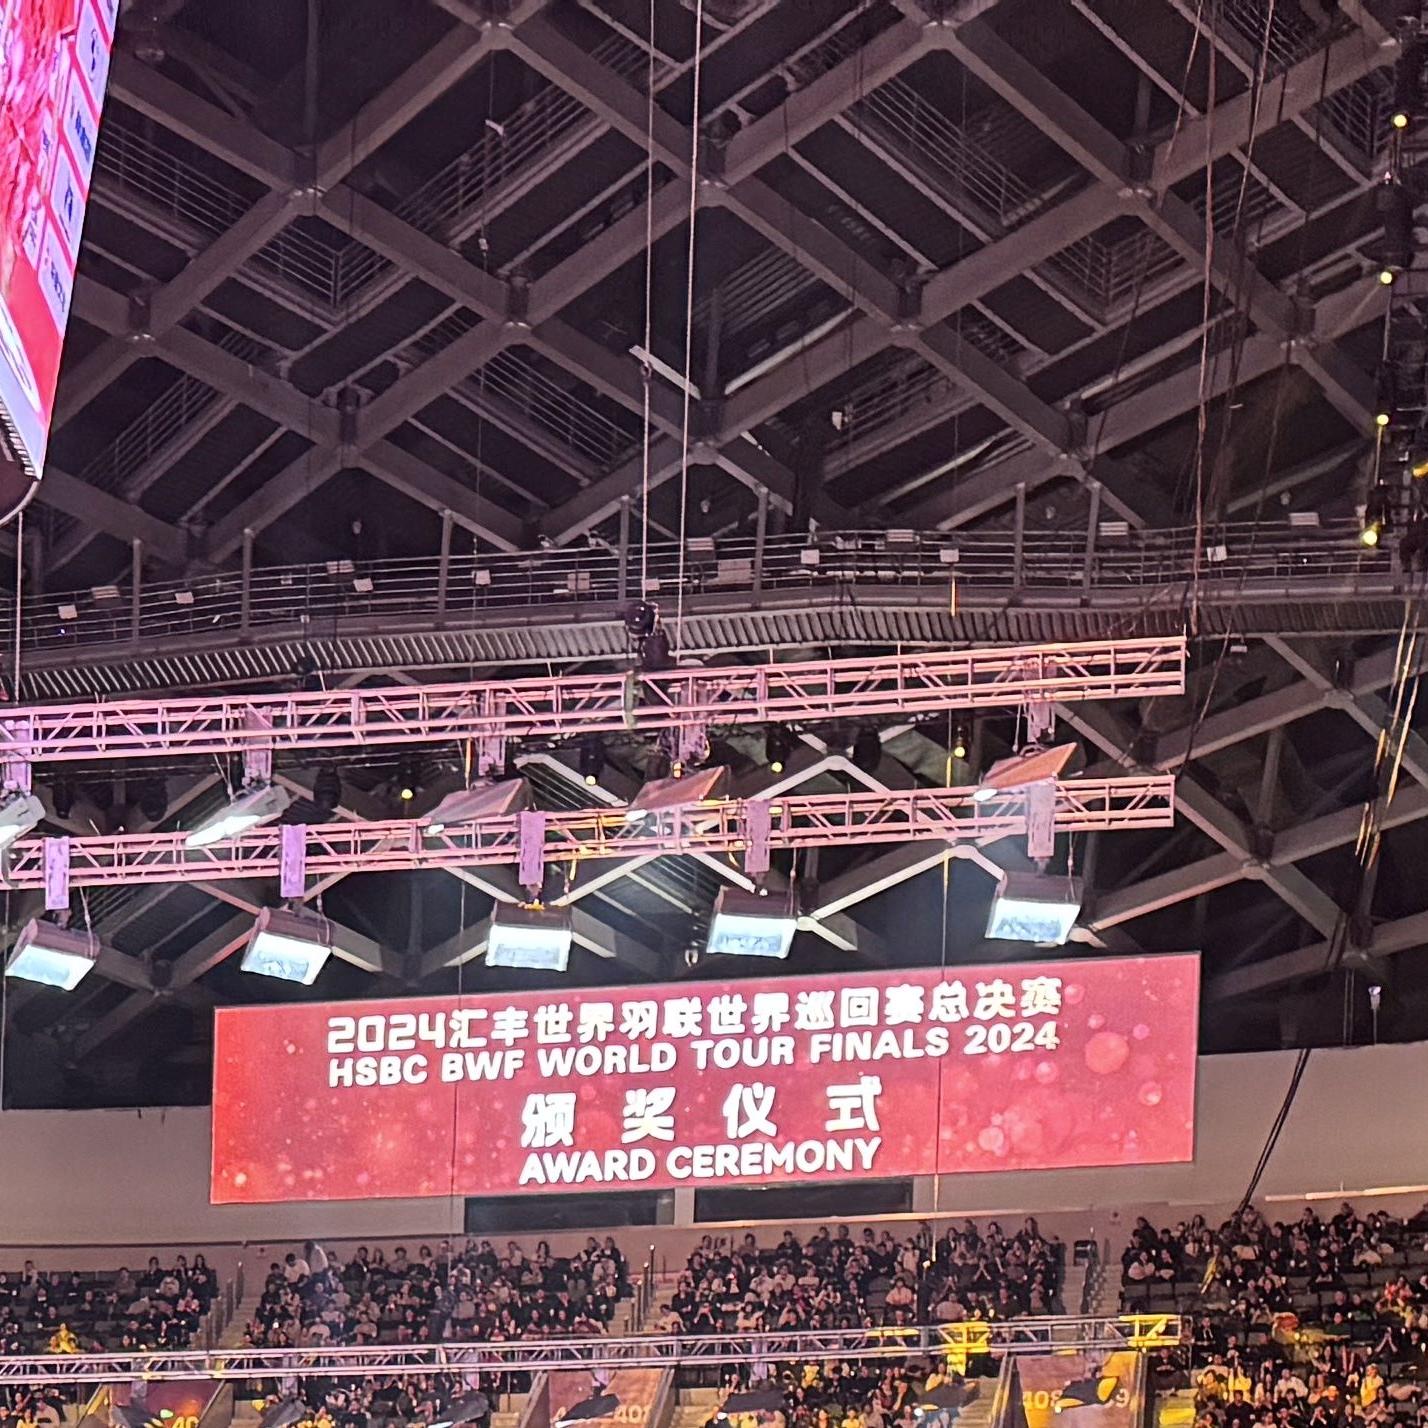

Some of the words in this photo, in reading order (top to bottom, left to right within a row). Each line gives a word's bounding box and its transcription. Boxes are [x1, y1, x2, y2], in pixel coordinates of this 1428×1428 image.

[327, 976, 1062, 1053] 2024汇丰世界羽联世界巡回赛总决赛
[328, 1054, 428, 1088] HSBC
[441, 1050, 525, 1083] BWF
[537, 1042, 677, 1077] WORLD
[690, 1035, 794, 1070] TOUR
[810, 1026, 949, 1064] FINALS
[963, 1021, 1061, 1055] 2024
[521, 1075, 882, 1148] 颁奖仪式
[519, 1148, 655, 1185] AWARD
[666, 1136, 882, 1178] CEREMONY
